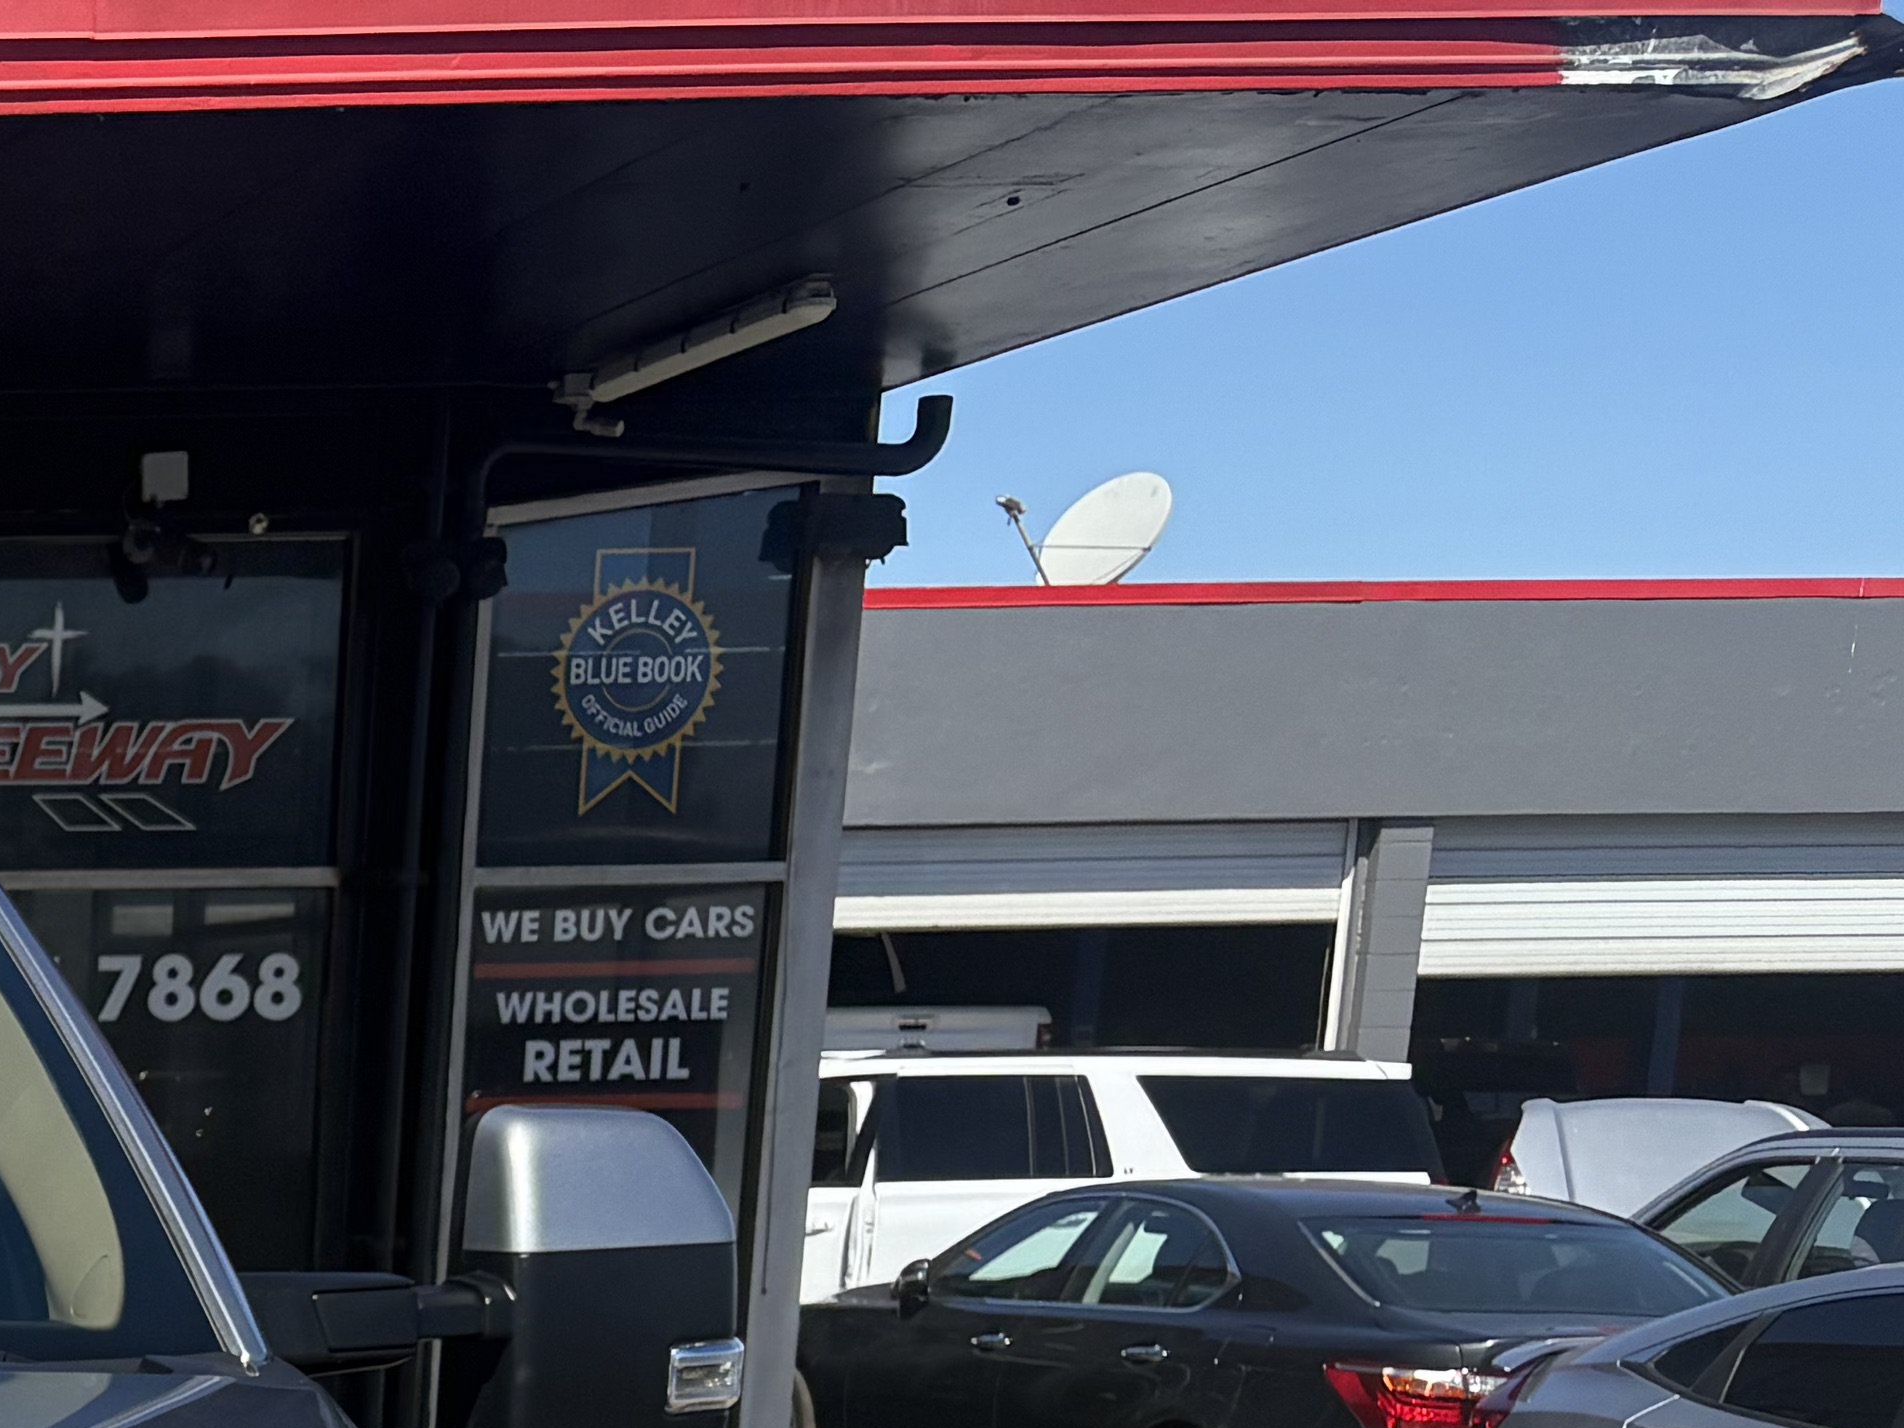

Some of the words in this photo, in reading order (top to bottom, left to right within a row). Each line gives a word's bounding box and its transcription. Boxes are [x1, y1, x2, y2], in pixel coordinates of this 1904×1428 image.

[587, 598, 697, 646] KELLEY
[569, 655, 633, 685] BLUE
[637, 653, 704, 683] BOOK
[581, 694, 642, 738] OFFICIAL
[644, 693, 689, 735] GUIDE
[481, 911, 540, 944] WE
[553, 907, 633, 942] BUY
[644, 905, 755, 940] CARS
[96, 953, 302, 1023] 7868
[496, 987, 730, 1025] WHOLESALE
[523, 1038, 690, 1083] RETAIL
